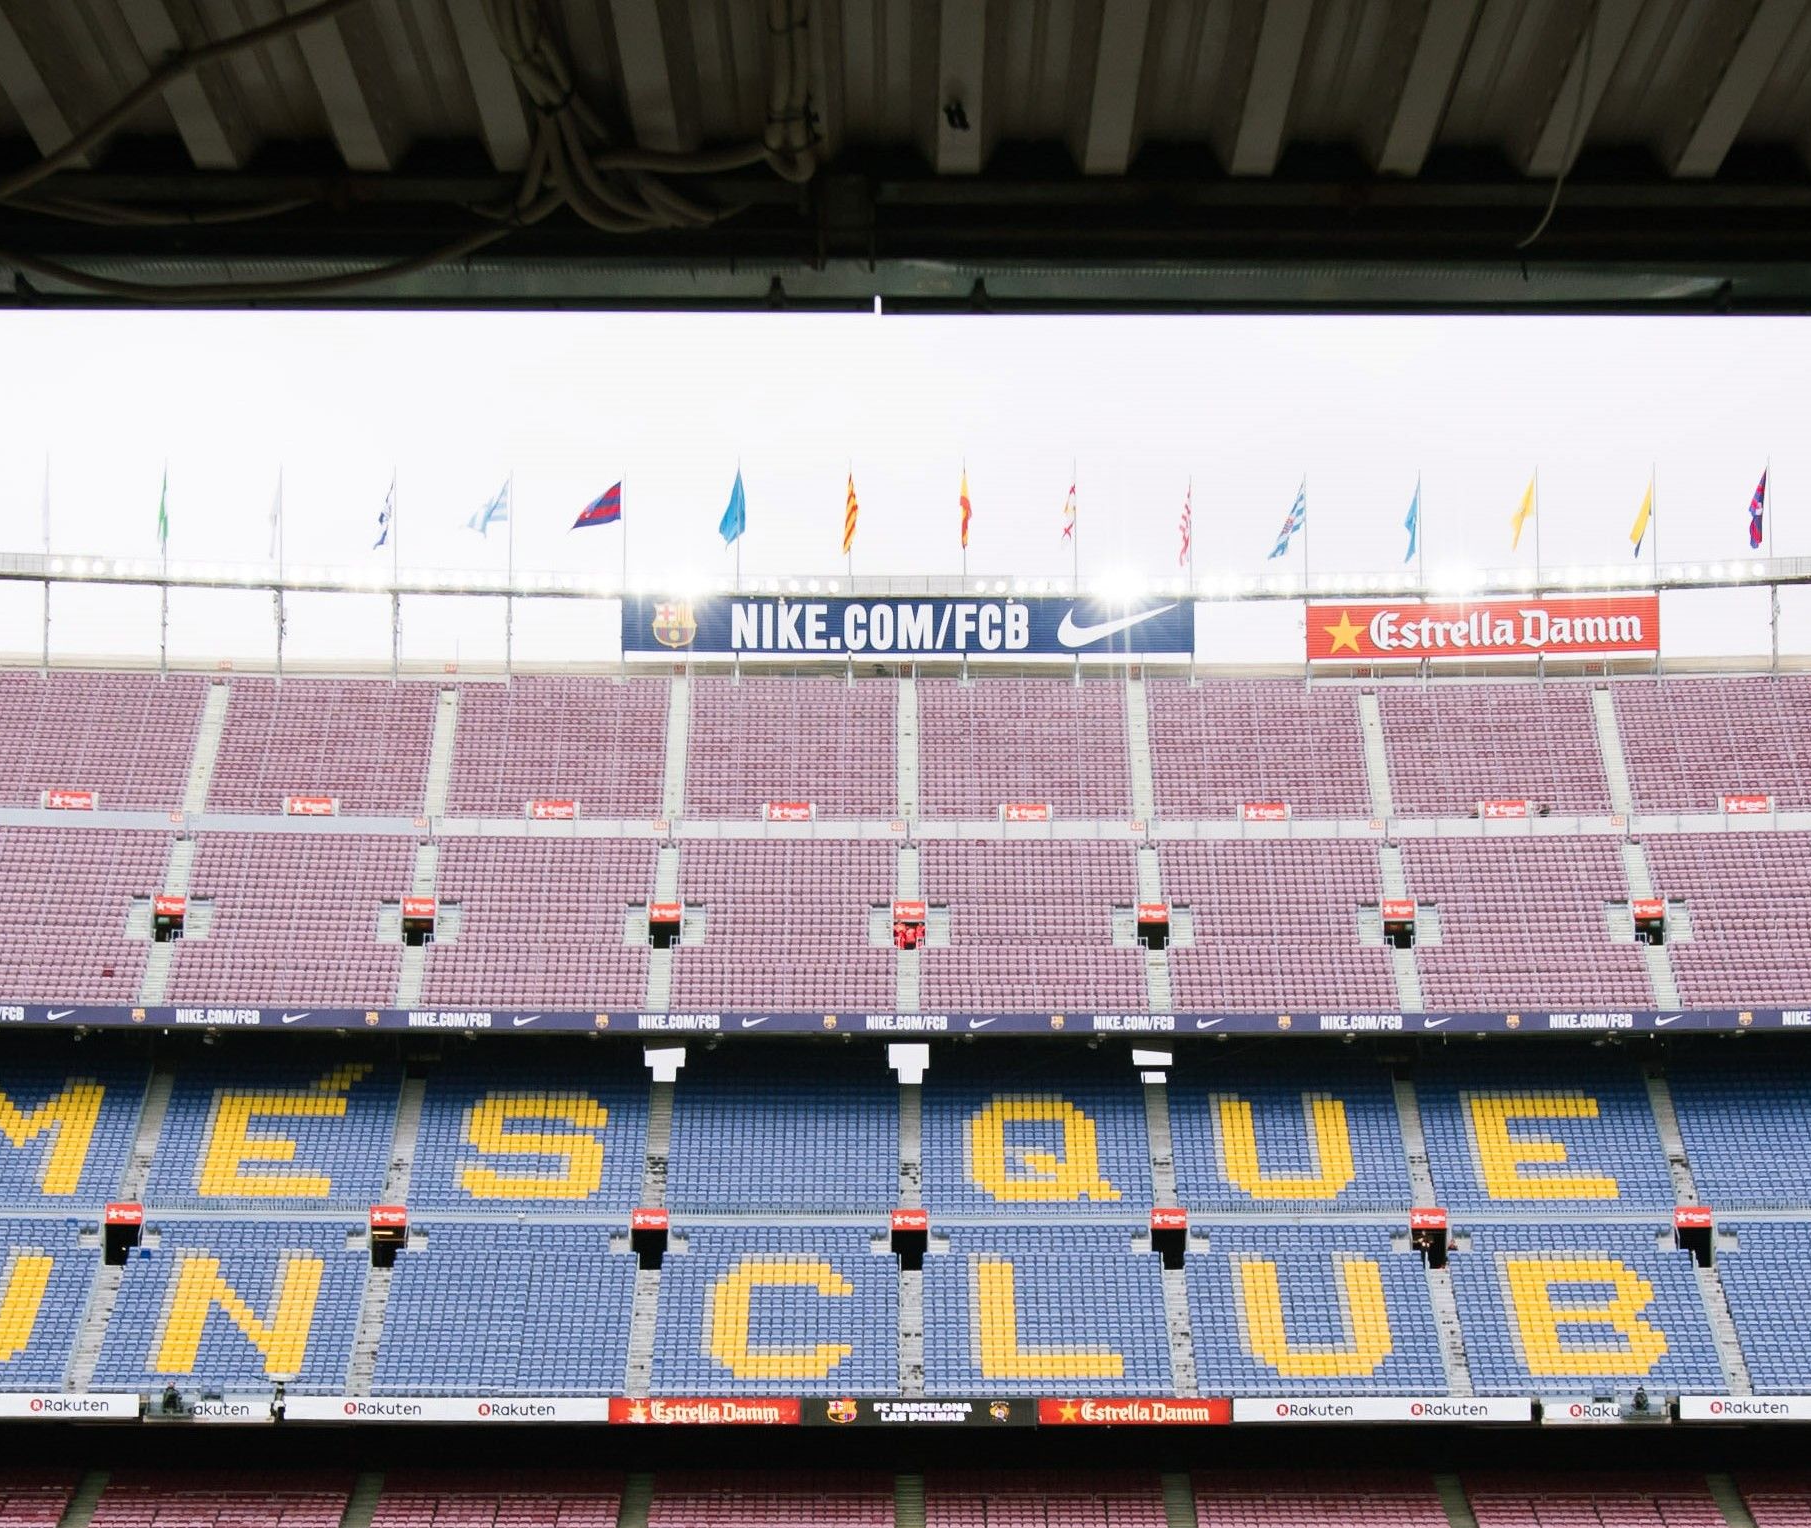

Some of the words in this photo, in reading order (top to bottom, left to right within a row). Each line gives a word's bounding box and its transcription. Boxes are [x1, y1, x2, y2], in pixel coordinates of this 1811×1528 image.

[731, 603, 1029, 650] NIKE.COM/FCB
[1369, 609, 1515, 650] Estrella
[1519, 608, 1644, 647] Damm
[176, 1008, 260, 1024] NIKE.COM/FCB
[408, 1012, 491, 1028] NIKE.COM/FCB
[638, 1014, 720, 1030] NIKE.COM/FCB
[866, 1015, 948, 1031] NIKE.COM/FCB
[1093, 1015, 1175, 1031] NIKE.COM/FCB
[1320, 1014, 1403, 1030] NIKE.COM/FCB
[1549, 1013, 1633, 1029] NIKE.COM/FCB
[967, 1096, 1620, 1202] QUE
[708, 1255, 1670, 1380] CLUB
[45, 1399, 108, 1411] Rakuten
[194, 1402, 249, 1416] akuten
[358, 1403, 421, 1415] Rakuten
[492, 1404, 555, 1415] Rakuten
[651, 1402, 730, 1421] Estrella
[732, 1404, 780, 1421] Damm
[873, 1403, 890, 1412] FC
[892, 1403, 972, 1412] BARCELONA
[1081, 1402, 1152, 1421] Estrella
[1153, 1403, 1209, 1421] Damm
[1290, 1404, 1353, 1416] Rakuten
[1425, 1403, 1487, 1415] Rakuten
[1584, 1402, 1620, 1417] Raku
[1725, 1401, 1788, 1413] Rakuten
[881, 1412, 906, 1421] LAS
[909, 1412, 965, 1421] PALMAS
